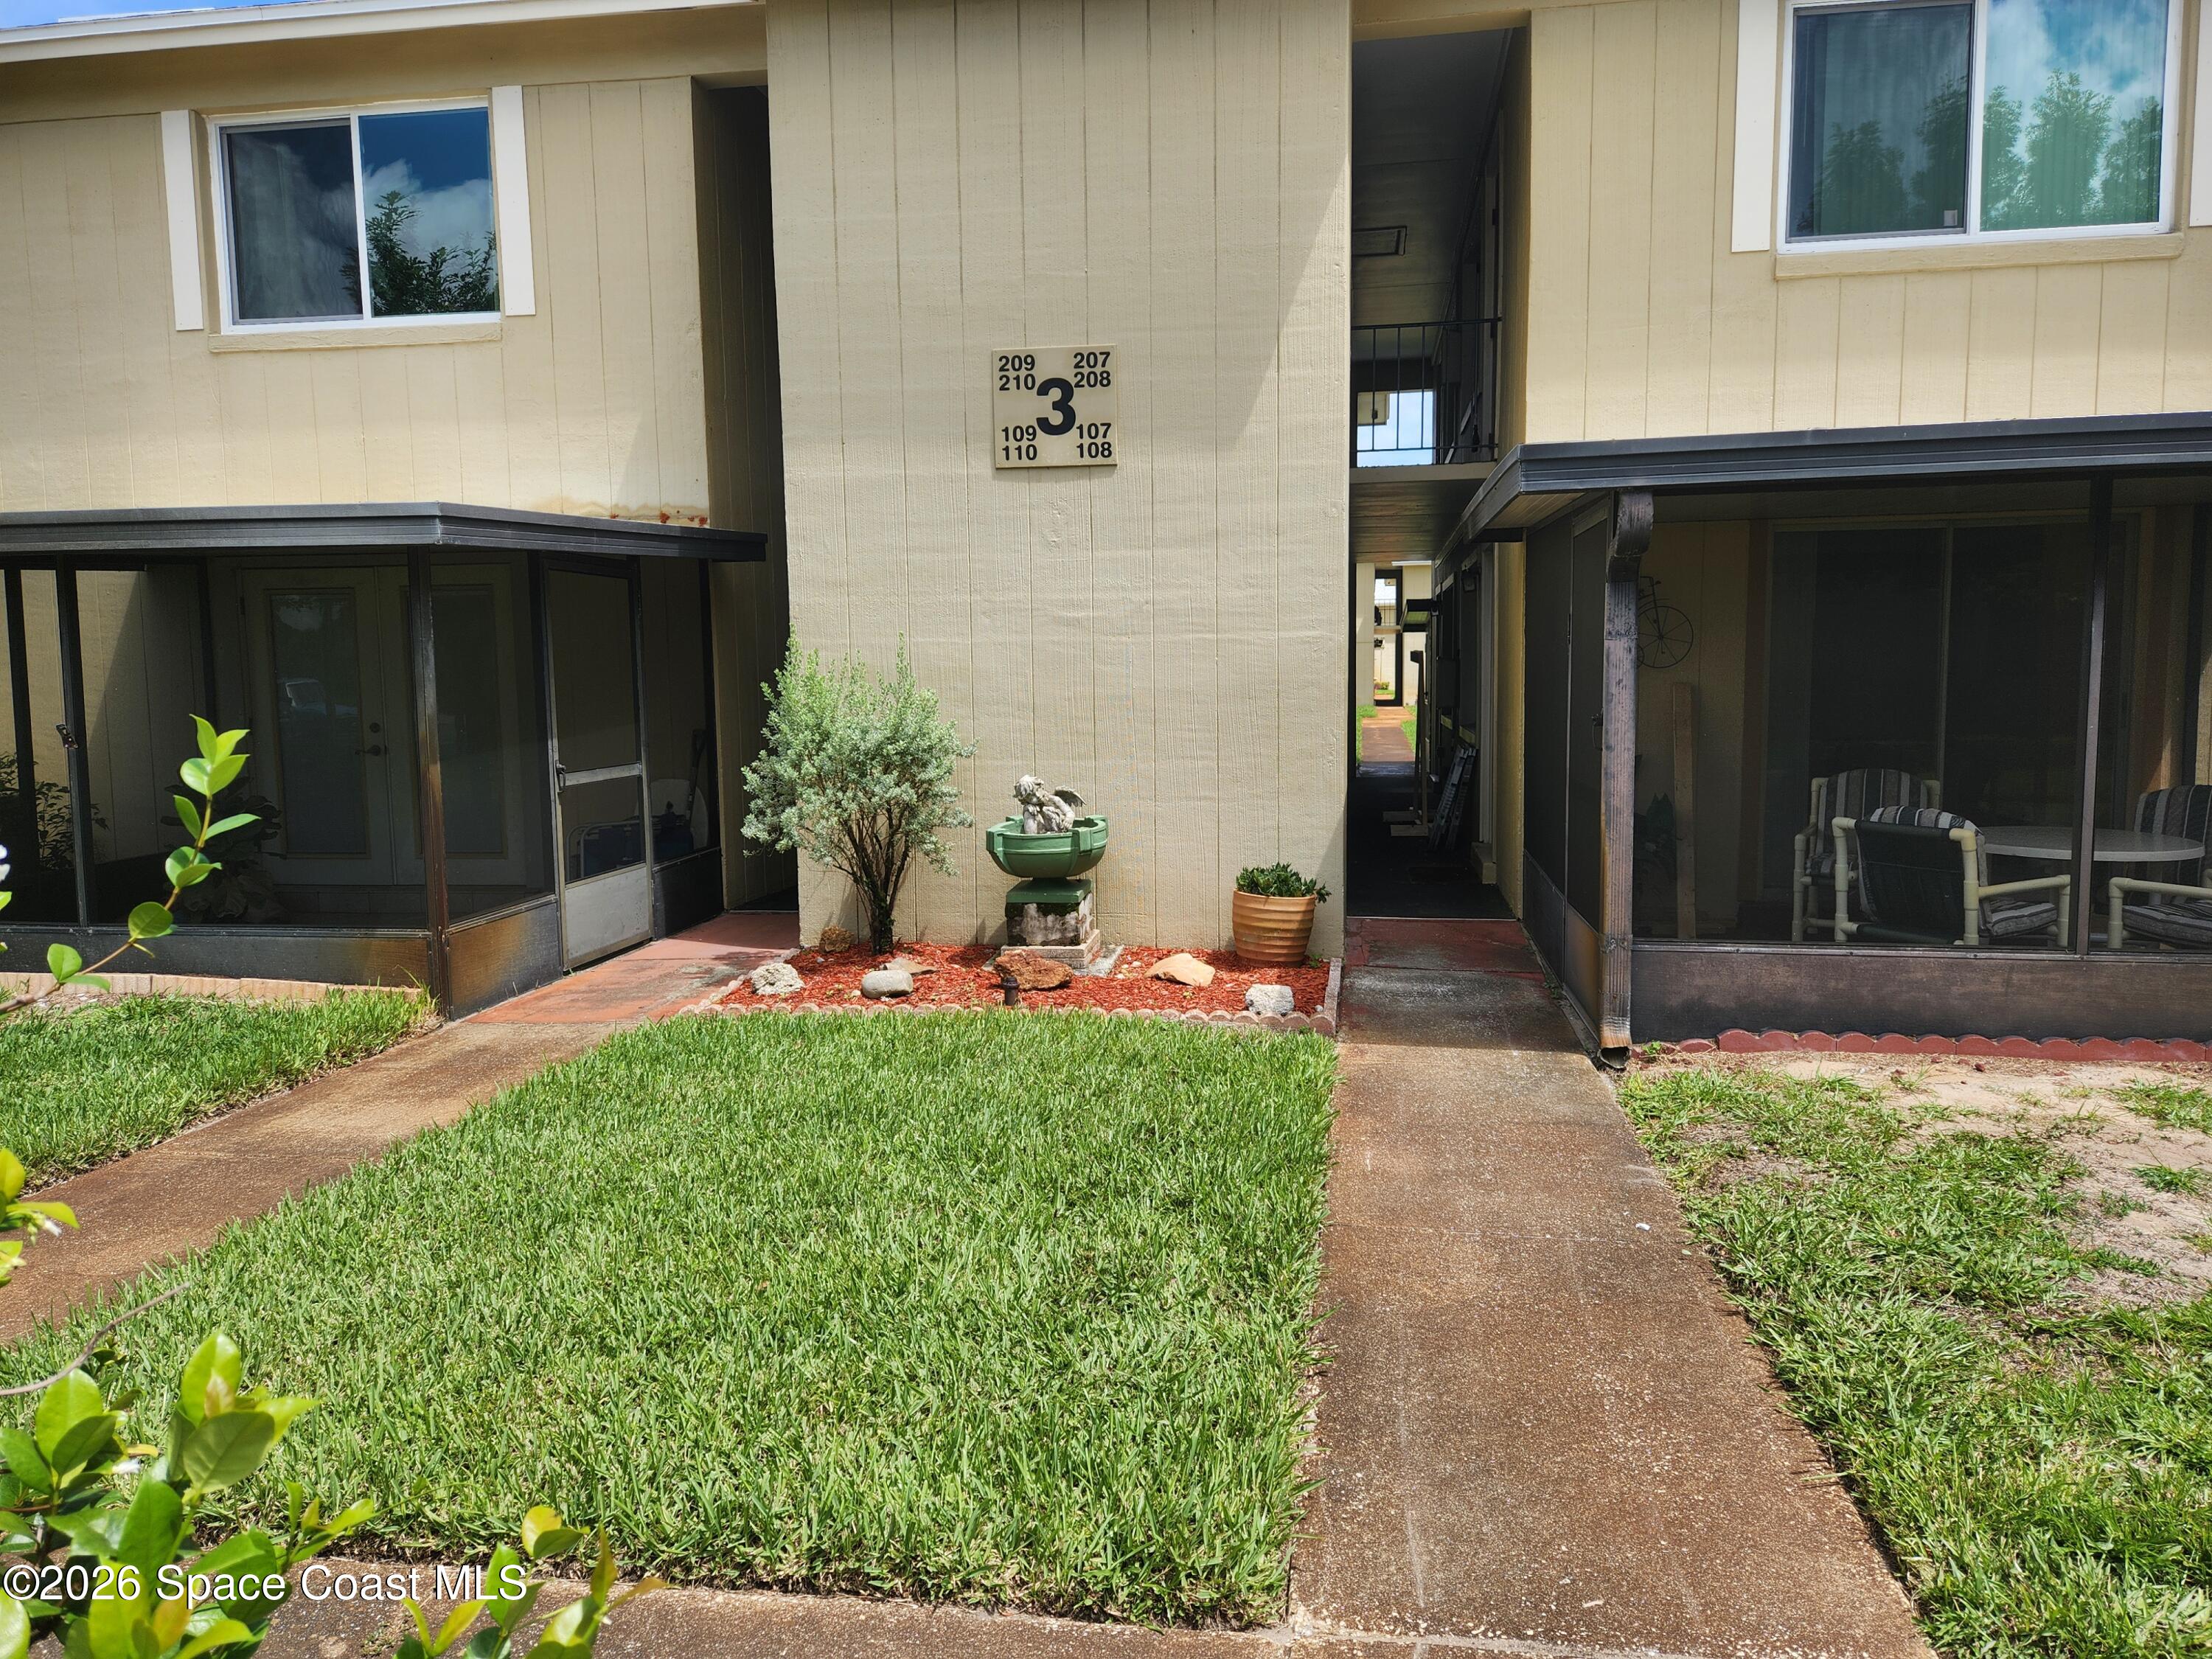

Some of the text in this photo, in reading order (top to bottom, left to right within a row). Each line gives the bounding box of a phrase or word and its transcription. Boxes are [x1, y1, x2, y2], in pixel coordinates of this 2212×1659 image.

[998, 354, 1035, 372] 209
[1074, 351, 1110, 369] 207
[999, 373, 1036, 391] 210
[1074, 370, 1111, 388] 208
[1036, 378, 1076, 436] 3
[1001, 425, 1037, 442] 109
[1076, 422, 1111, 439] 107
[1002, 444, 1037, 461] 110
[1076, 442, 1112, 459] 108
